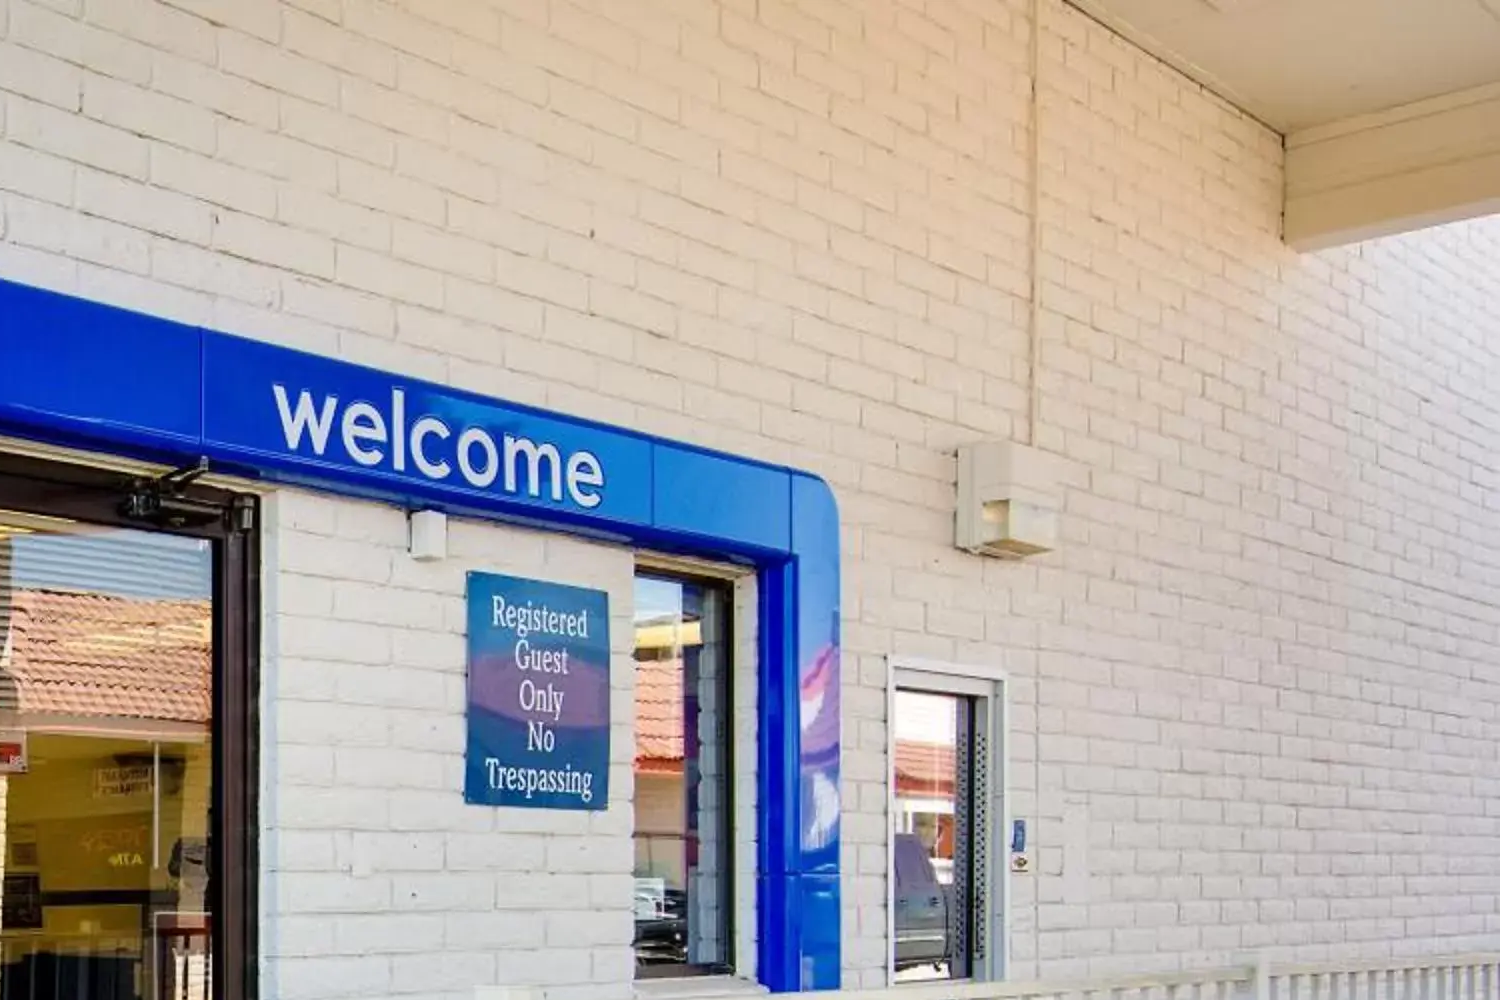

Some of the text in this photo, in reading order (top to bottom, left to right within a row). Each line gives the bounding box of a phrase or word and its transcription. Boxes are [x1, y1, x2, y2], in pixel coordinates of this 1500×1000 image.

[273, 386, 604, 507] welcome
[492, 595, 588, 638] Registered
[515, 639, 569, 675] Guest
[519, 679, 564, 721] Only
[527, 720, 555, 752] No
[485, 757, 592, 802] Trespassing
